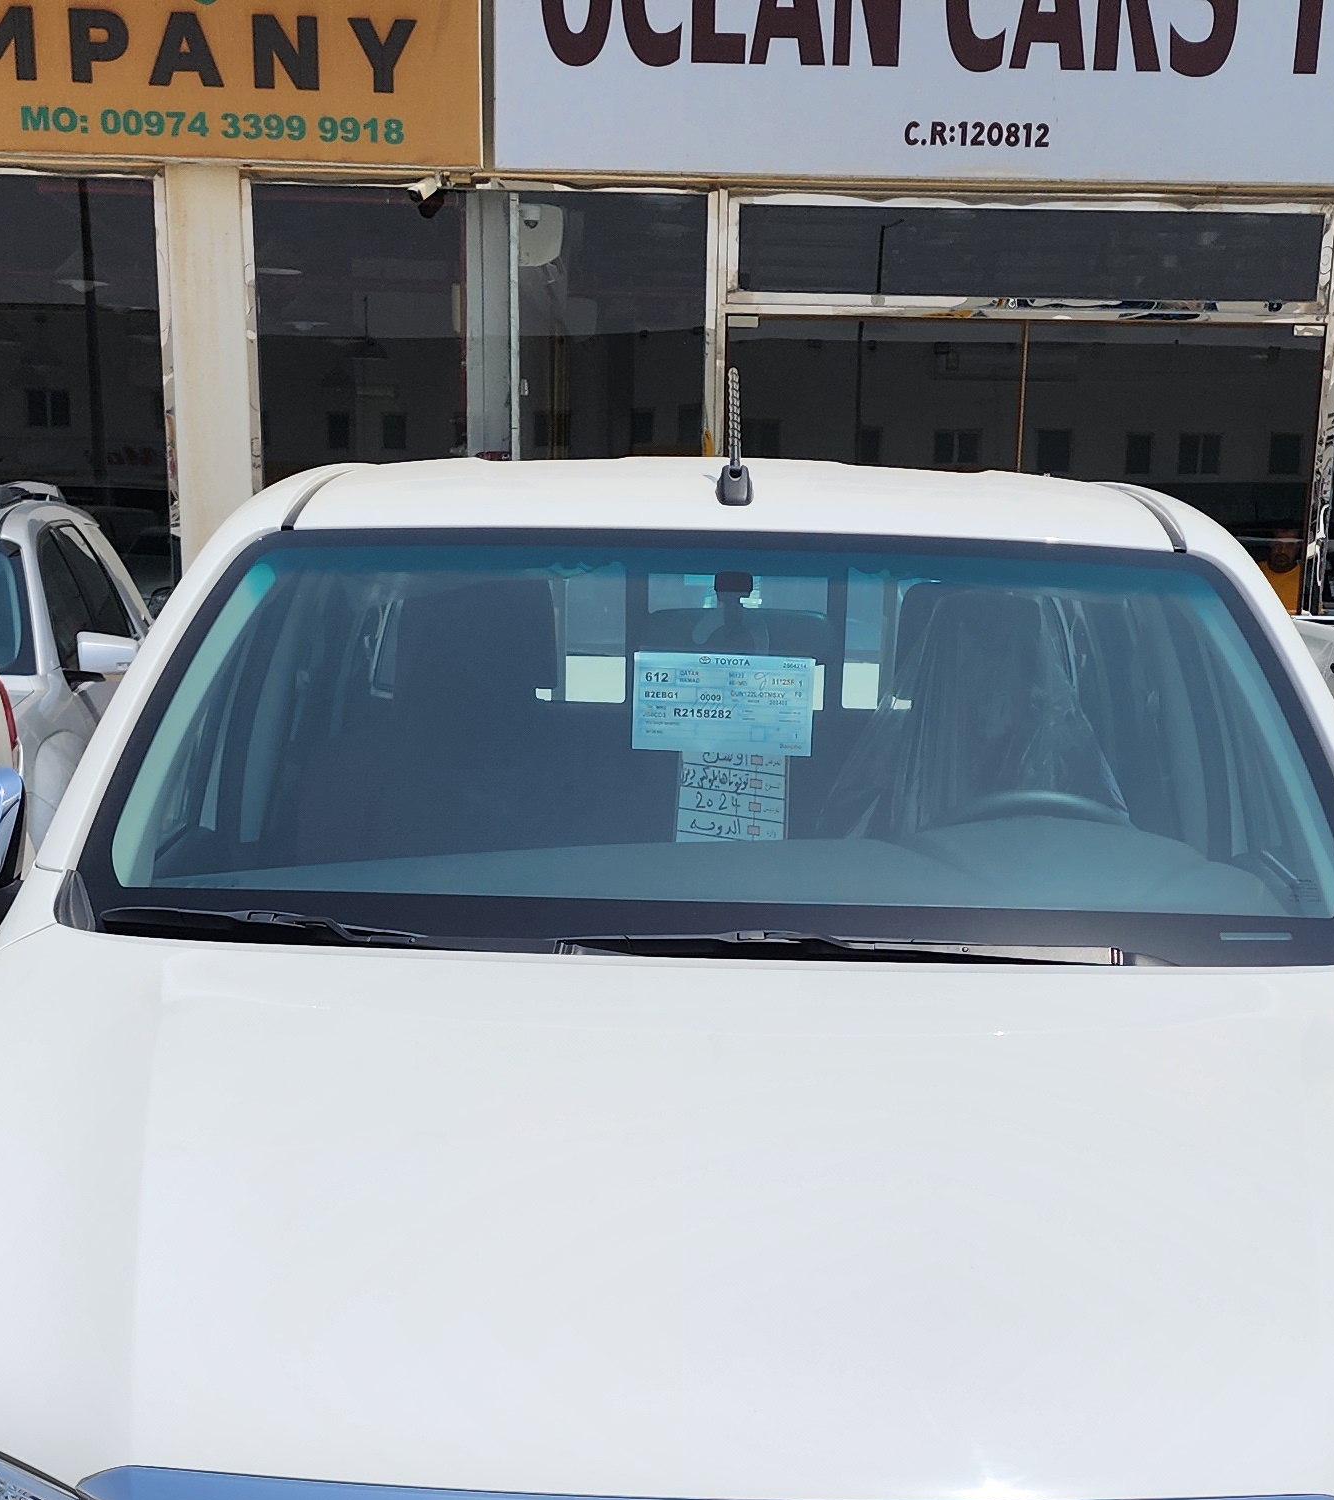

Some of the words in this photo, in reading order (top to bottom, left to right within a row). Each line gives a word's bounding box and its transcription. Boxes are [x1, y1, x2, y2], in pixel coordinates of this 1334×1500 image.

[20, 106, 88, 134] MO:
[100, 109, 209, 137] 00974
[221, 113, 307, 141] 3399
[318, 117, 404, 145] 9918
[904, 120, 1051, 149] C.R:120812
[715, 658, 751, 667] TOYOTA
[645, 672, 669, 683] 612
[673, 708, 732, 719] R2158282
